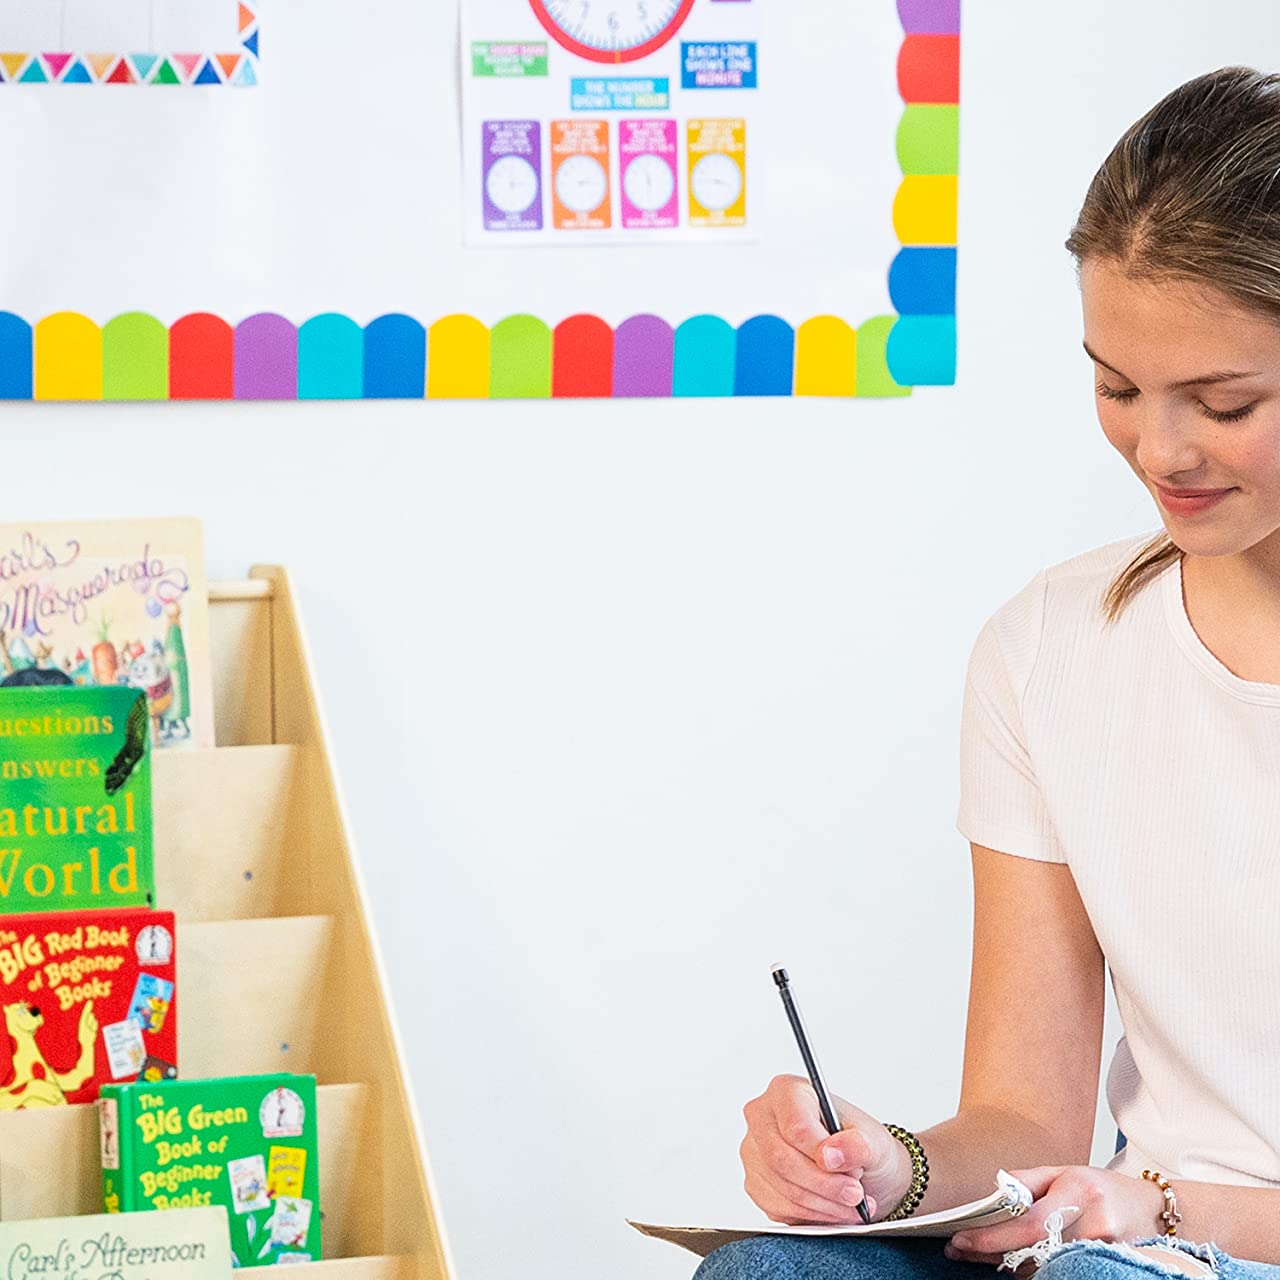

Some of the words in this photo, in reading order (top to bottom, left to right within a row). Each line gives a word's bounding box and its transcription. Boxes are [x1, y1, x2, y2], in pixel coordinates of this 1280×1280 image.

[607, 11, 618, 30] 6
[685, 58, 725, 72] SHOWS
[687, 45, 719, 58] EACH
[720, 45, 748, 58] LINE
[585, 80, 606, 93] THE
[606, 80, 655, 93] NUMBER
[695, 71, 743, 86] MINUTE
[573, 94, 612, 107] SHOWS
[613, 94, 633, 107] THE
[0, 531, 80, 580] arl's
[11, 543, 189, 636] Masquerade
[0, 708, 114, 736] uestions
[2, 758, 100, 779] nswers
[0, 792, 135, 836] atural
[0, 930, 17, 947] he
[0, 933, 45, 985] BIG
[44, 926, 82, 955] Red
[84, 925, 129, 949] Book
[27, 970, 43, 992] of
[44, 955, 125, 988] Beginner
[54, 976, 112, 1011] Books
[139, 1094, 164, 1110] The
[136, 1107, 183, 1143] BIG
[187, 1104, 248, 1130] Green
[155, 1135, 202, 1165] Book
[207, 1135, 229, 1153] of
[139, 1165, 222, 1197] Beginner
[81, 1232, 205, 1268] Afternoon
